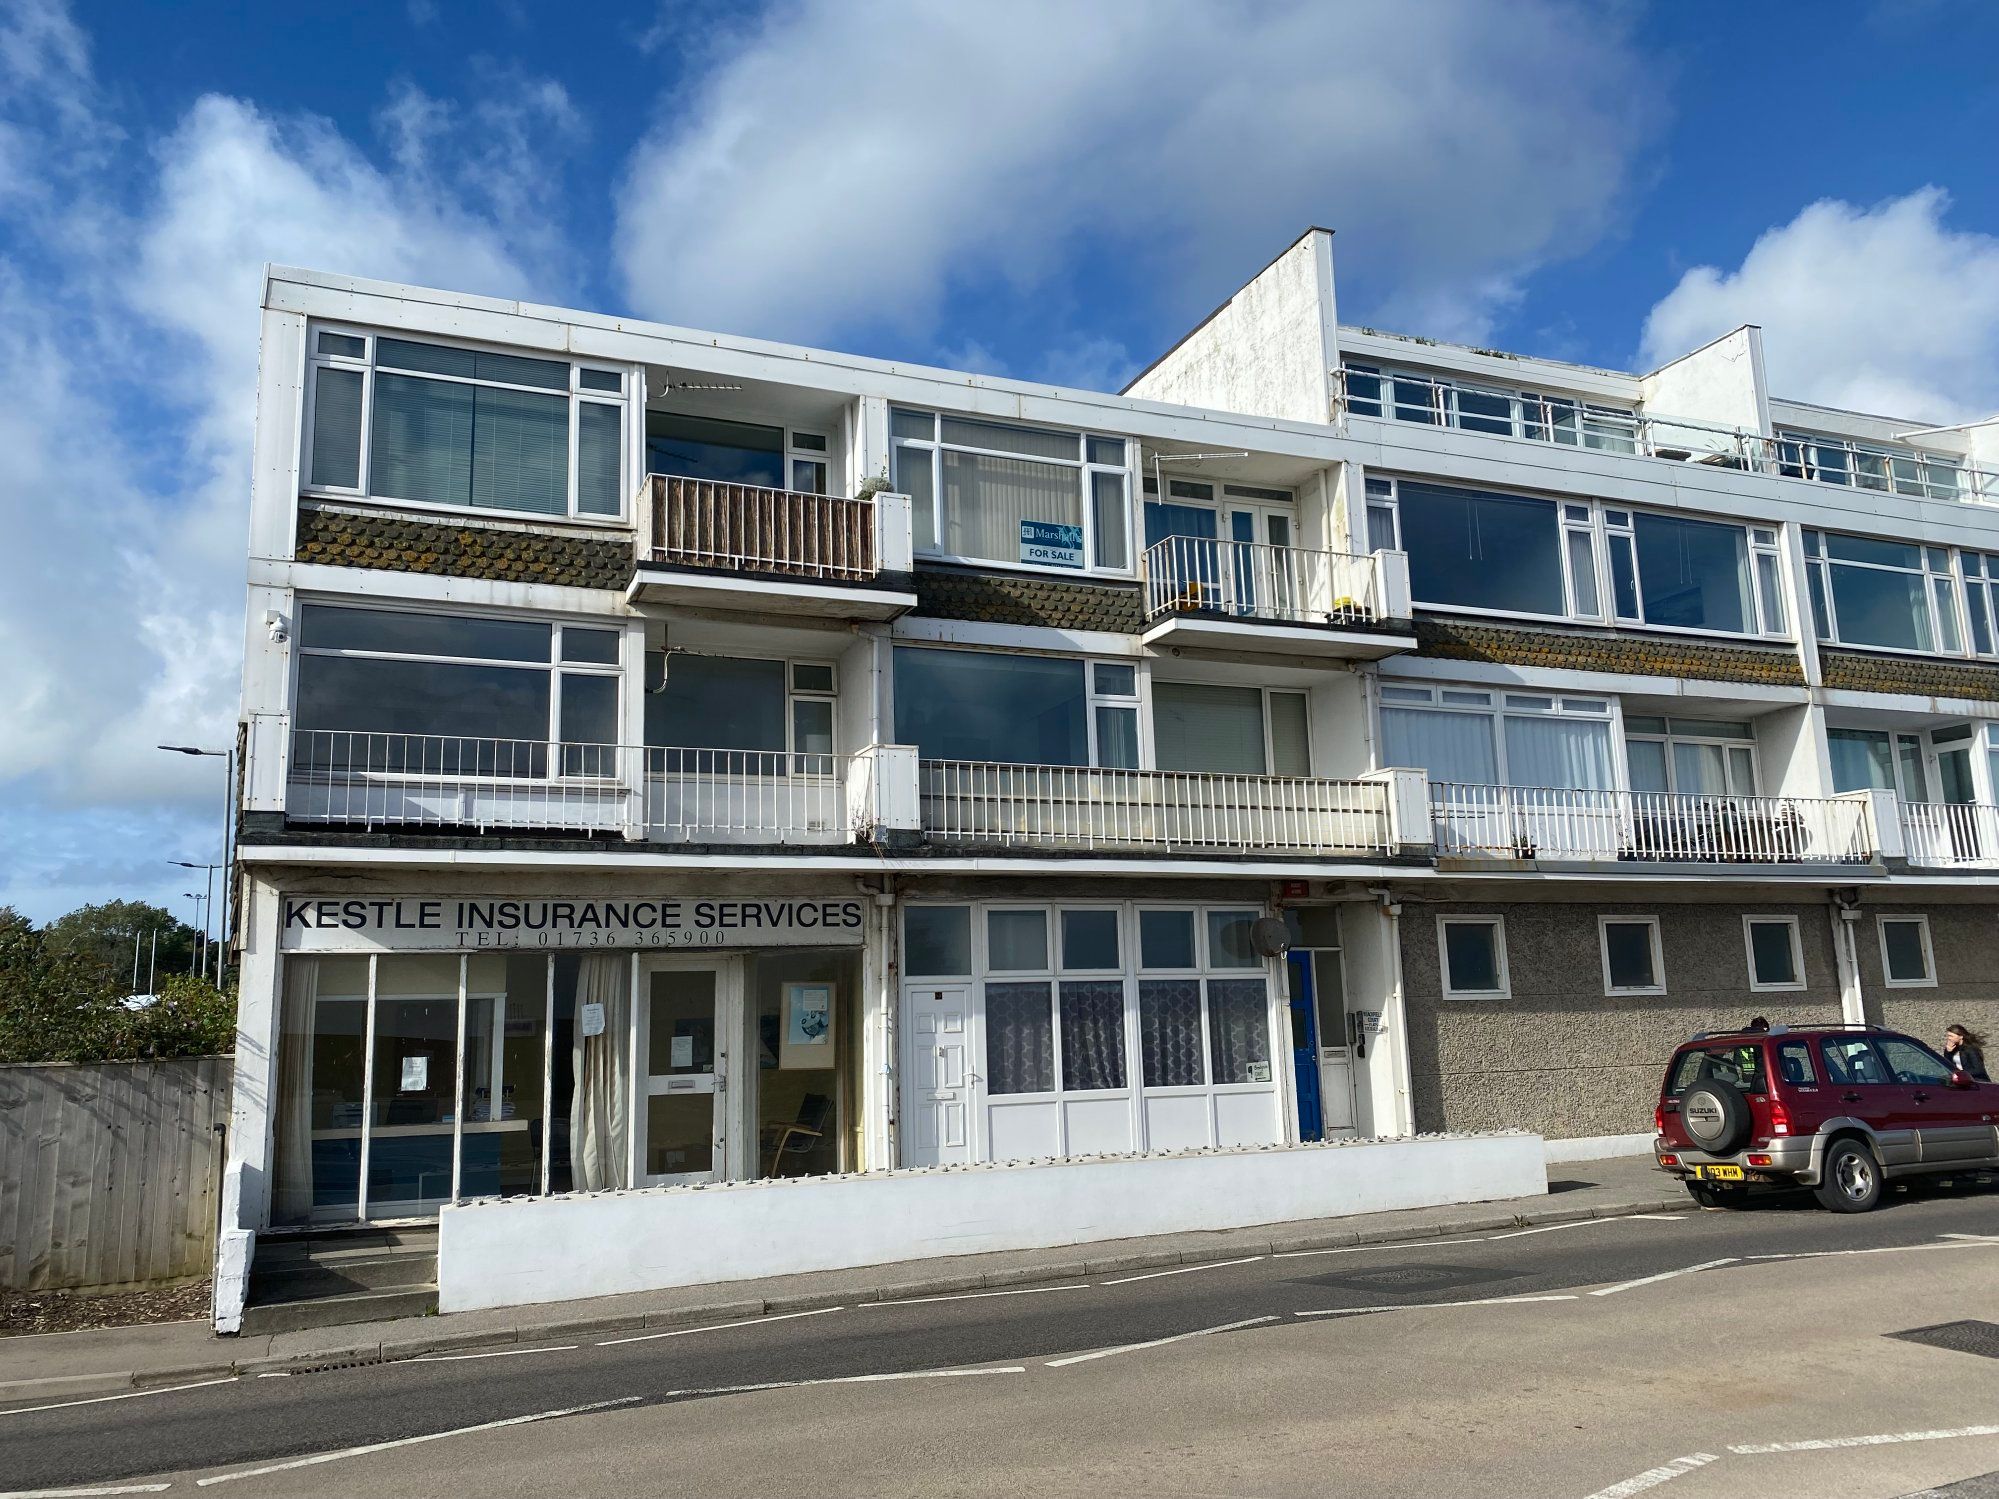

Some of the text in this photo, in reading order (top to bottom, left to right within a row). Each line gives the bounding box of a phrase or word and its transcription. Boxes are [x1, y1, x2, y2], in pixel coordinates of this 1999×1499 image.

[1029, 548, 1075, 561] FOR SALE
[285, 900, 862, 930] KESTLE INSURANCE SERVICES
[538, 930, 616, 946] 01736
[634, 930, 725, 945] 365900
